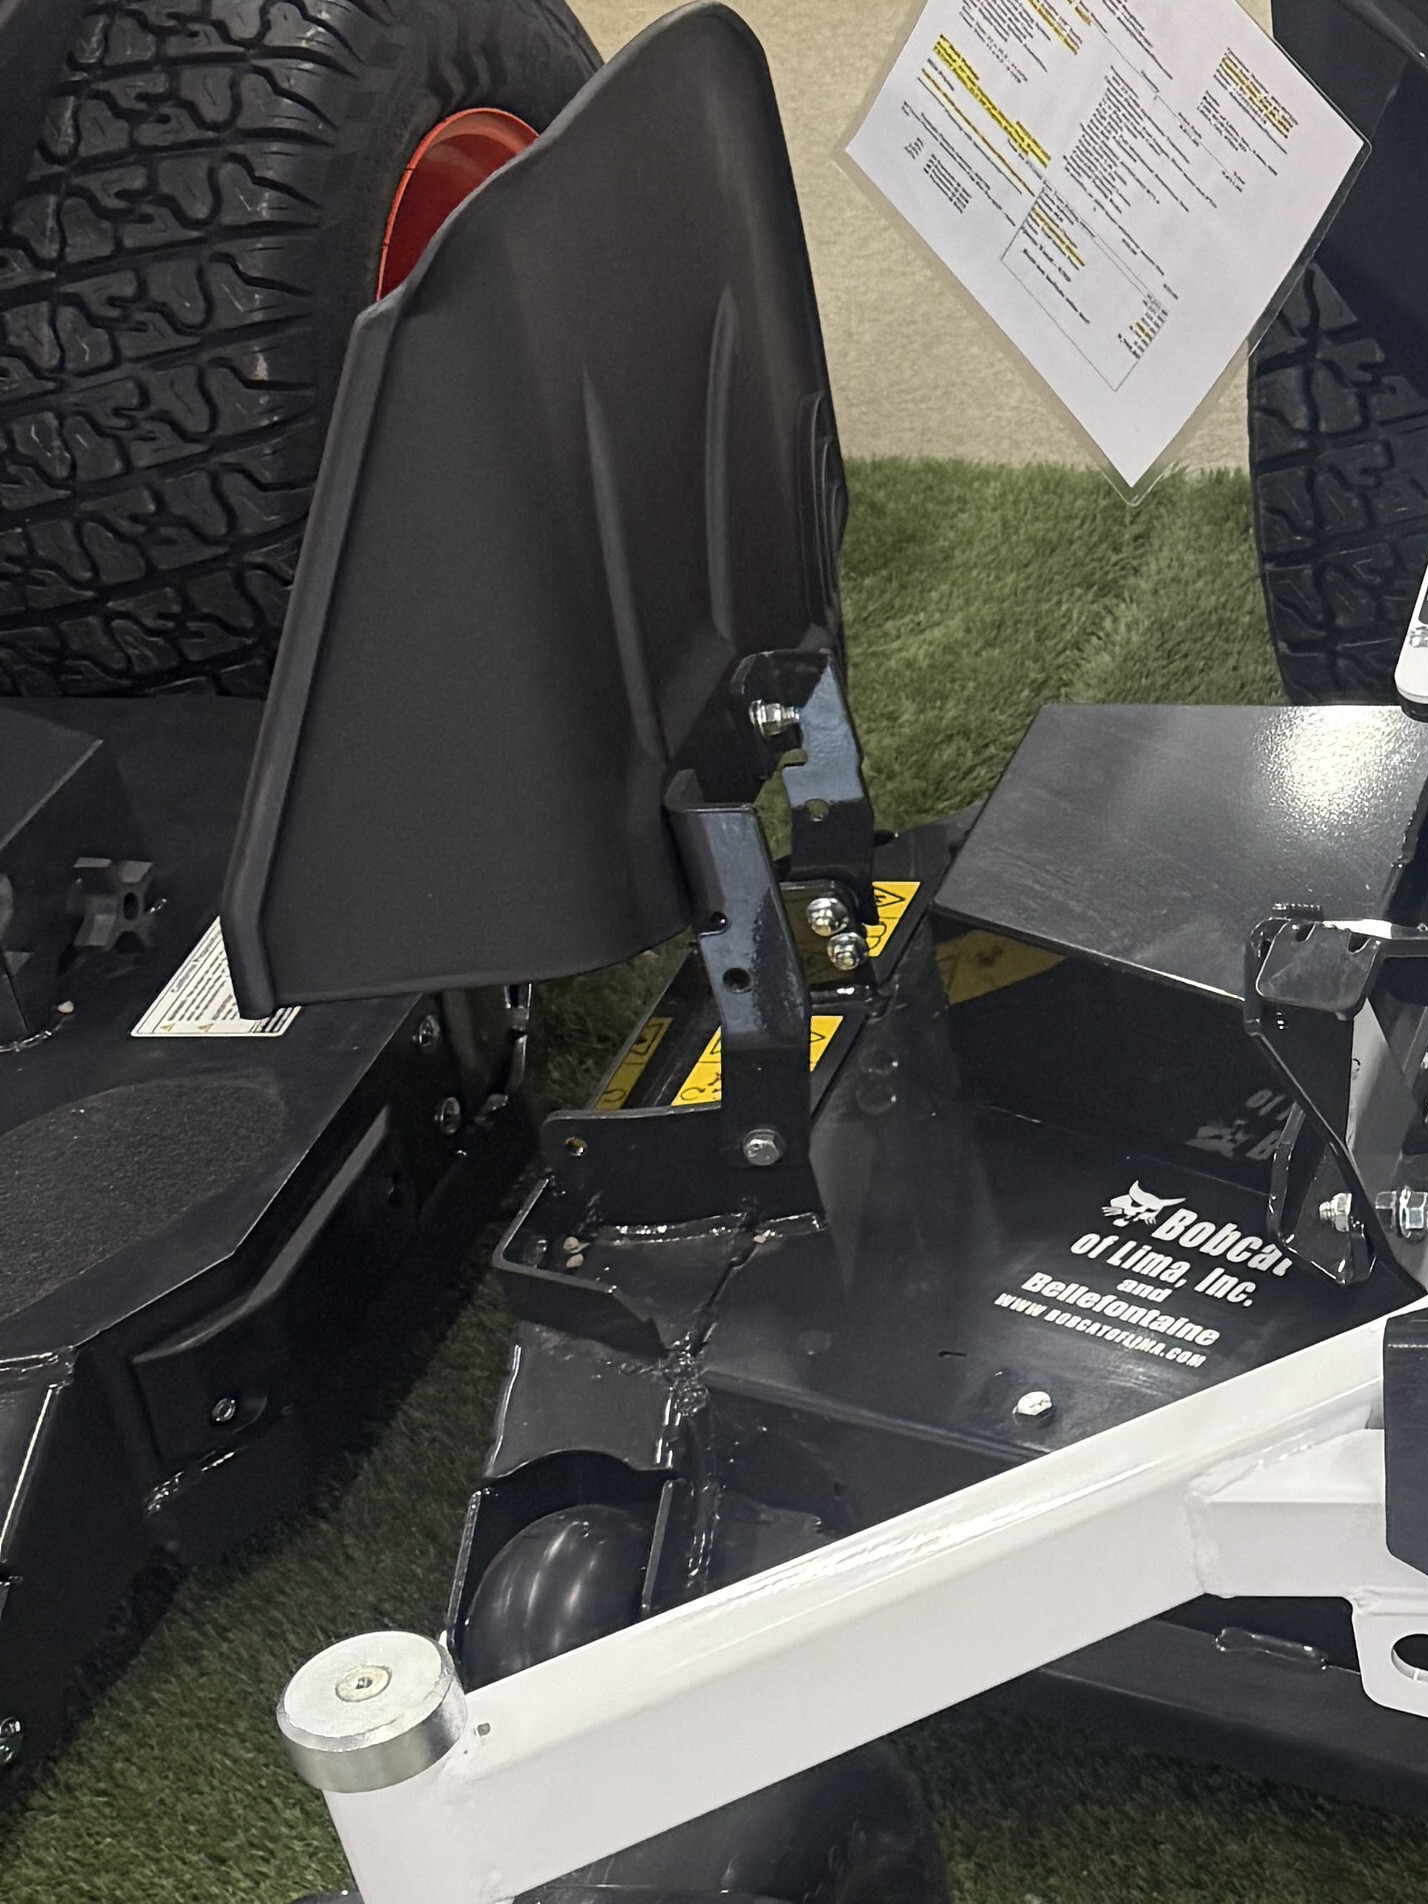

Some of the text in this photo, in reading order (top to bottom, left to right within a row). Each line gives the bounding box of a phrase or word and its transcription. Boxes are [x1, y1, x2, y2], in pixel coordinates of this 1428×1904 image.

[1070, 1233, 1256, 1307] of Lima, Inc.
[1116, 1279, 1173, 1302] and
[1021, 1272, 1220, 1346] Bellefontaine
